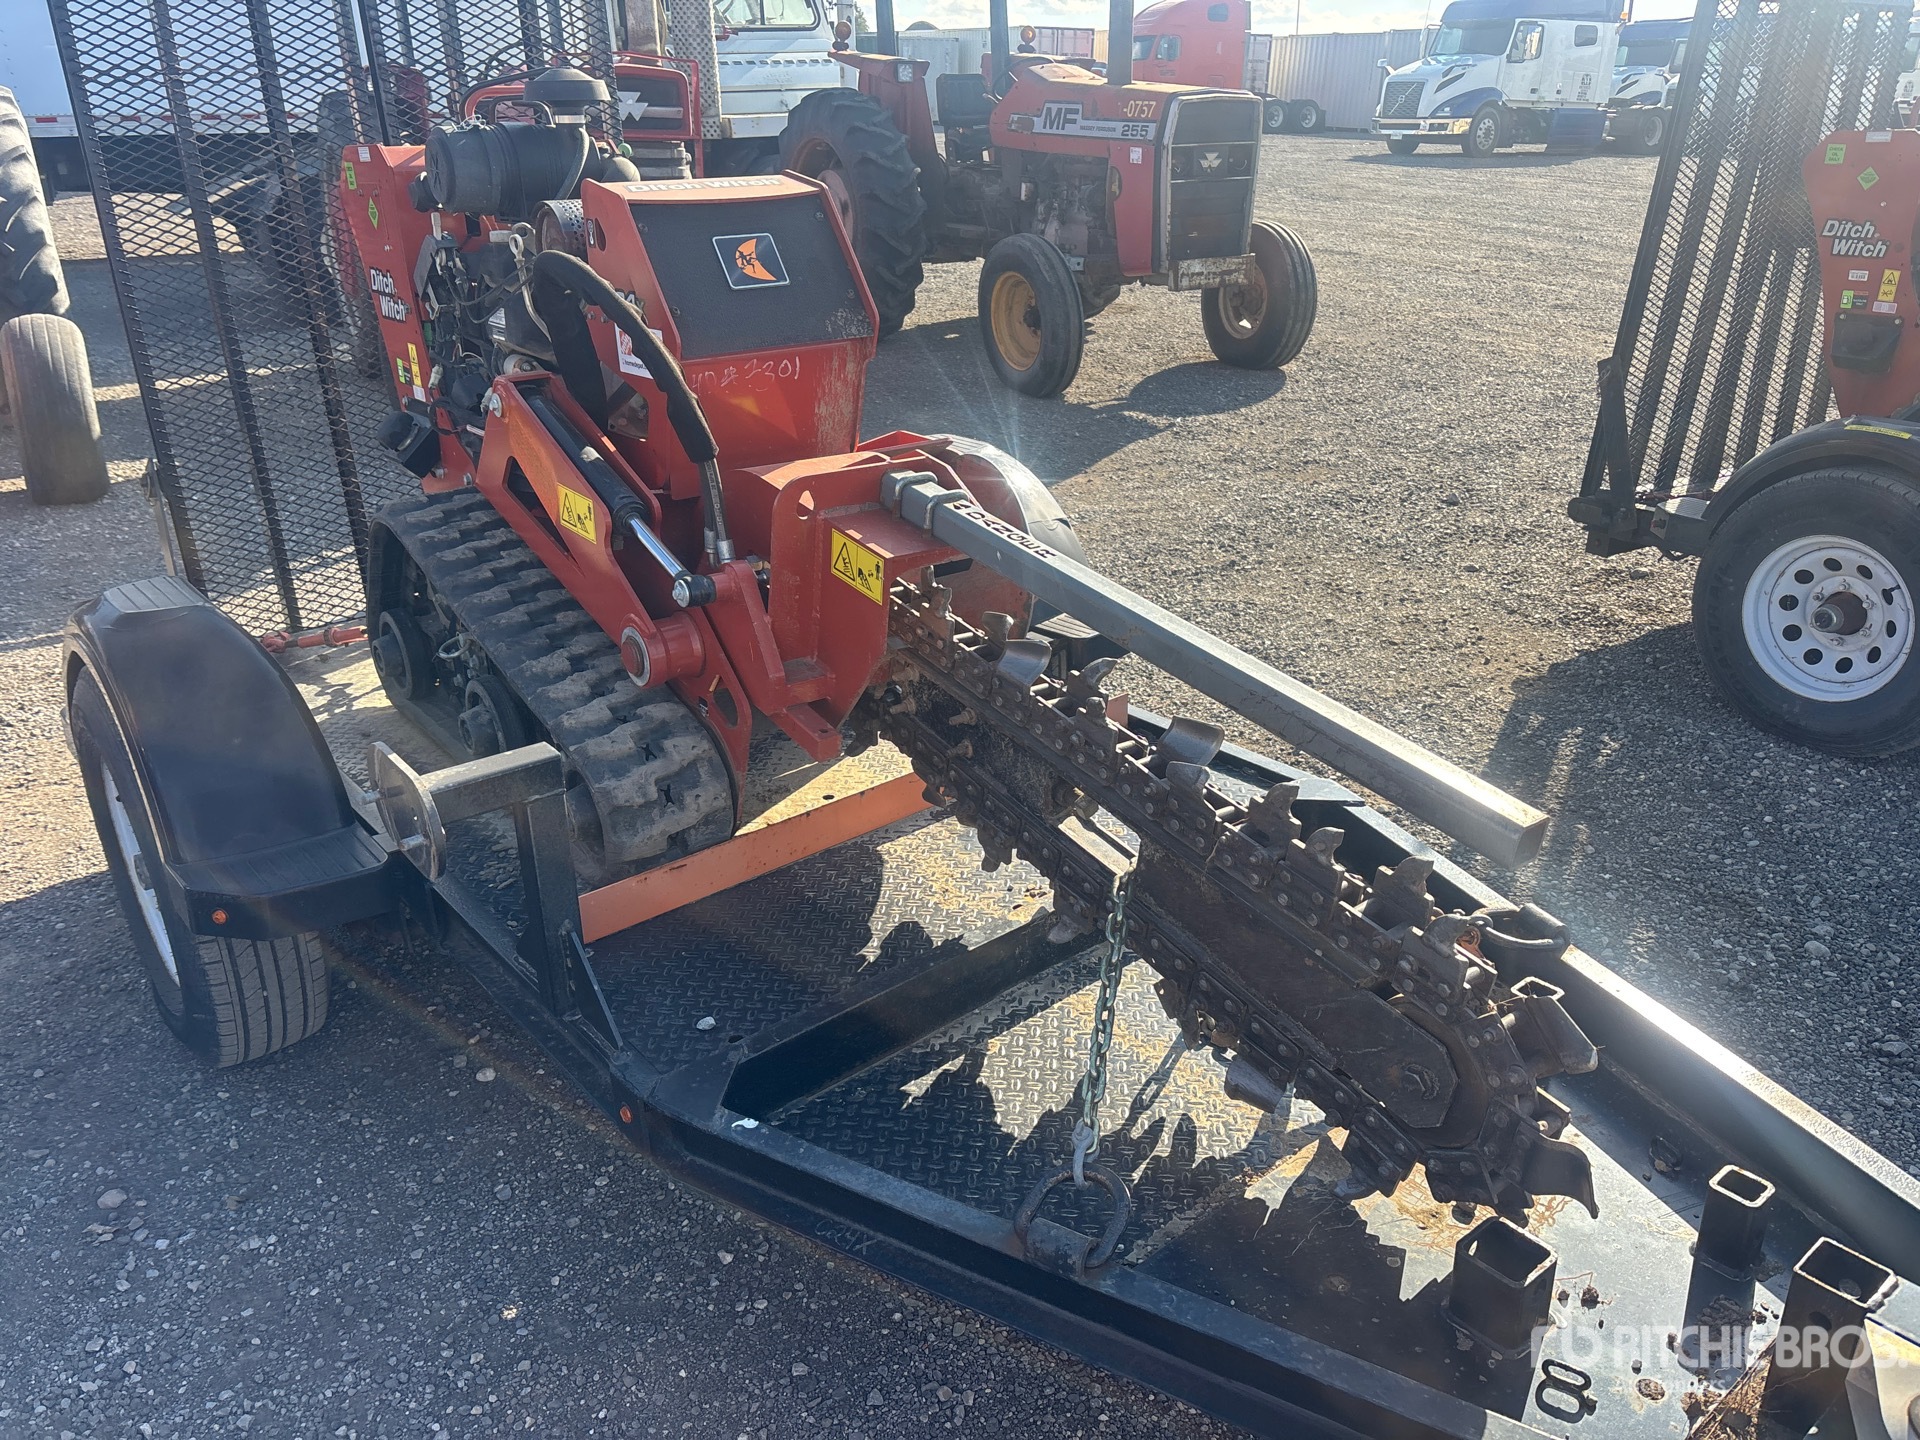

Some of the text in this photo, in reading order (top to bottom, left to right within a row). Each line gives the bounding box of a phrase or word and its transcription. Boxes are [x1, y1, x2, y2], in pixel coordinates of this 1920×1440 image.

[1042, 106, 1080, 131] MF
[1120, 124, 1150, 138] 255
[628, 178, 782, 193] Ditch Witch
[1821, 219, 1876, 238] Ditch
[1831, 238, 1888, 258] Witch
[369, 267, 397, 295] Ditch
[379, 294, 407, 322] Witch
[964, 511, 1058, 559] DANGER
